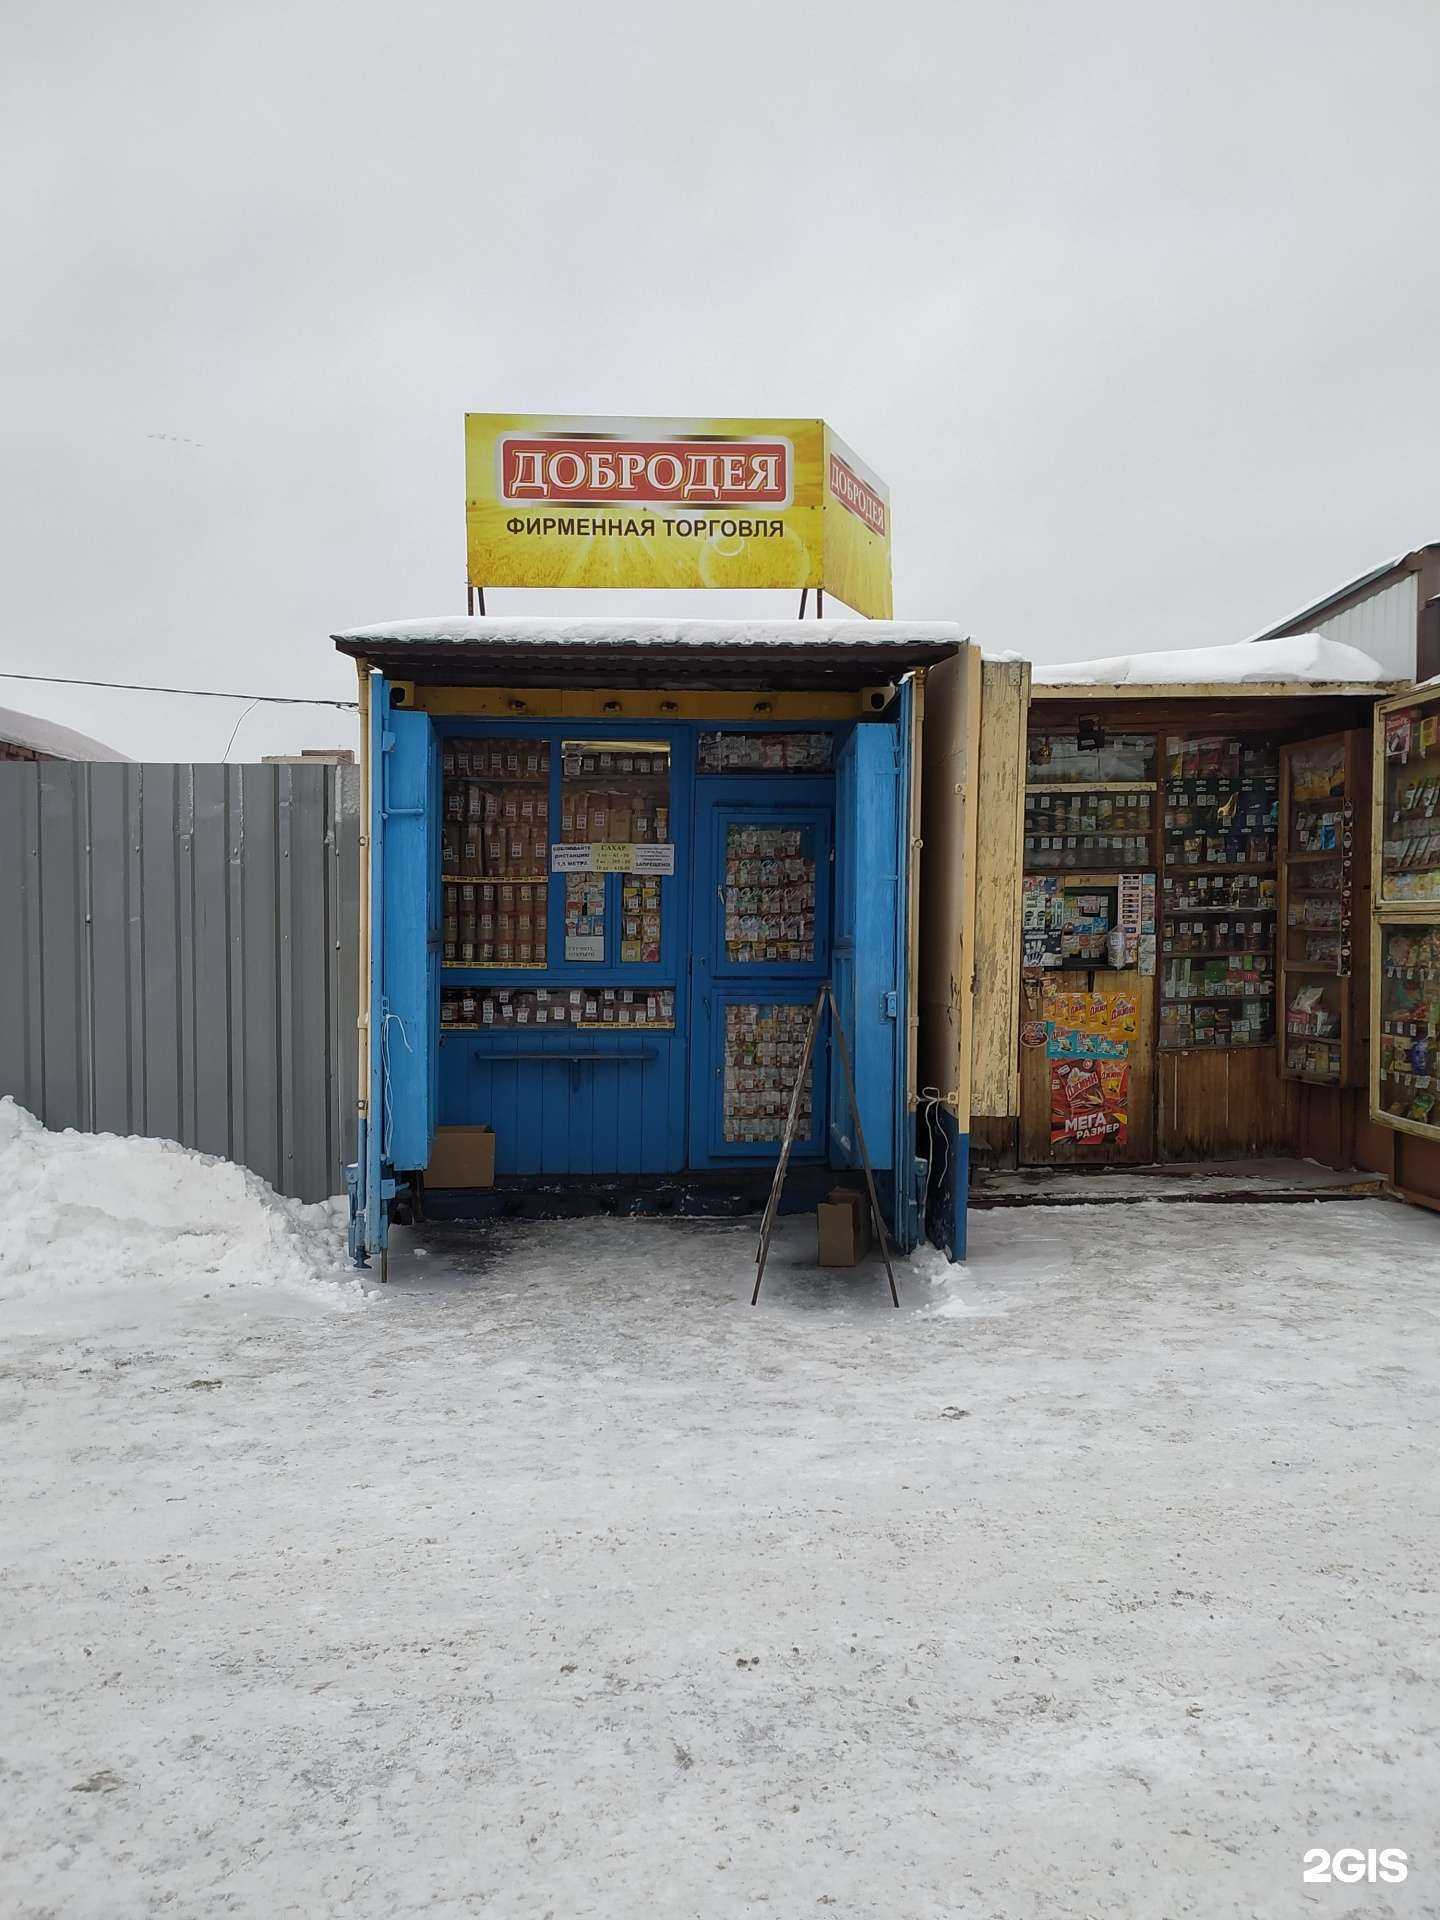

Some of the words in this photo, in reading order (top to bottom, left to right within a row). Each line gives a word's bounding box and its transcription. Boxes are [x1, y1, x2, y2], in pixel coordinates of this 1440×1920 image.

[510, 449, 780, 499] ДОБРОДЕЯ
[831, 462, 885, 530] ДОБРОДЕЯ
[507, 516, 656, 537] ФИРМЕННАЯ
[662, 518, 784, 538] ТОРГОВЛЯ
[601, 844, 626, 852] САХАР
[1065, 1112, 1107, 1133] МЕГА
[1076, 1123, 1120, 1140] РАЗМЕР
